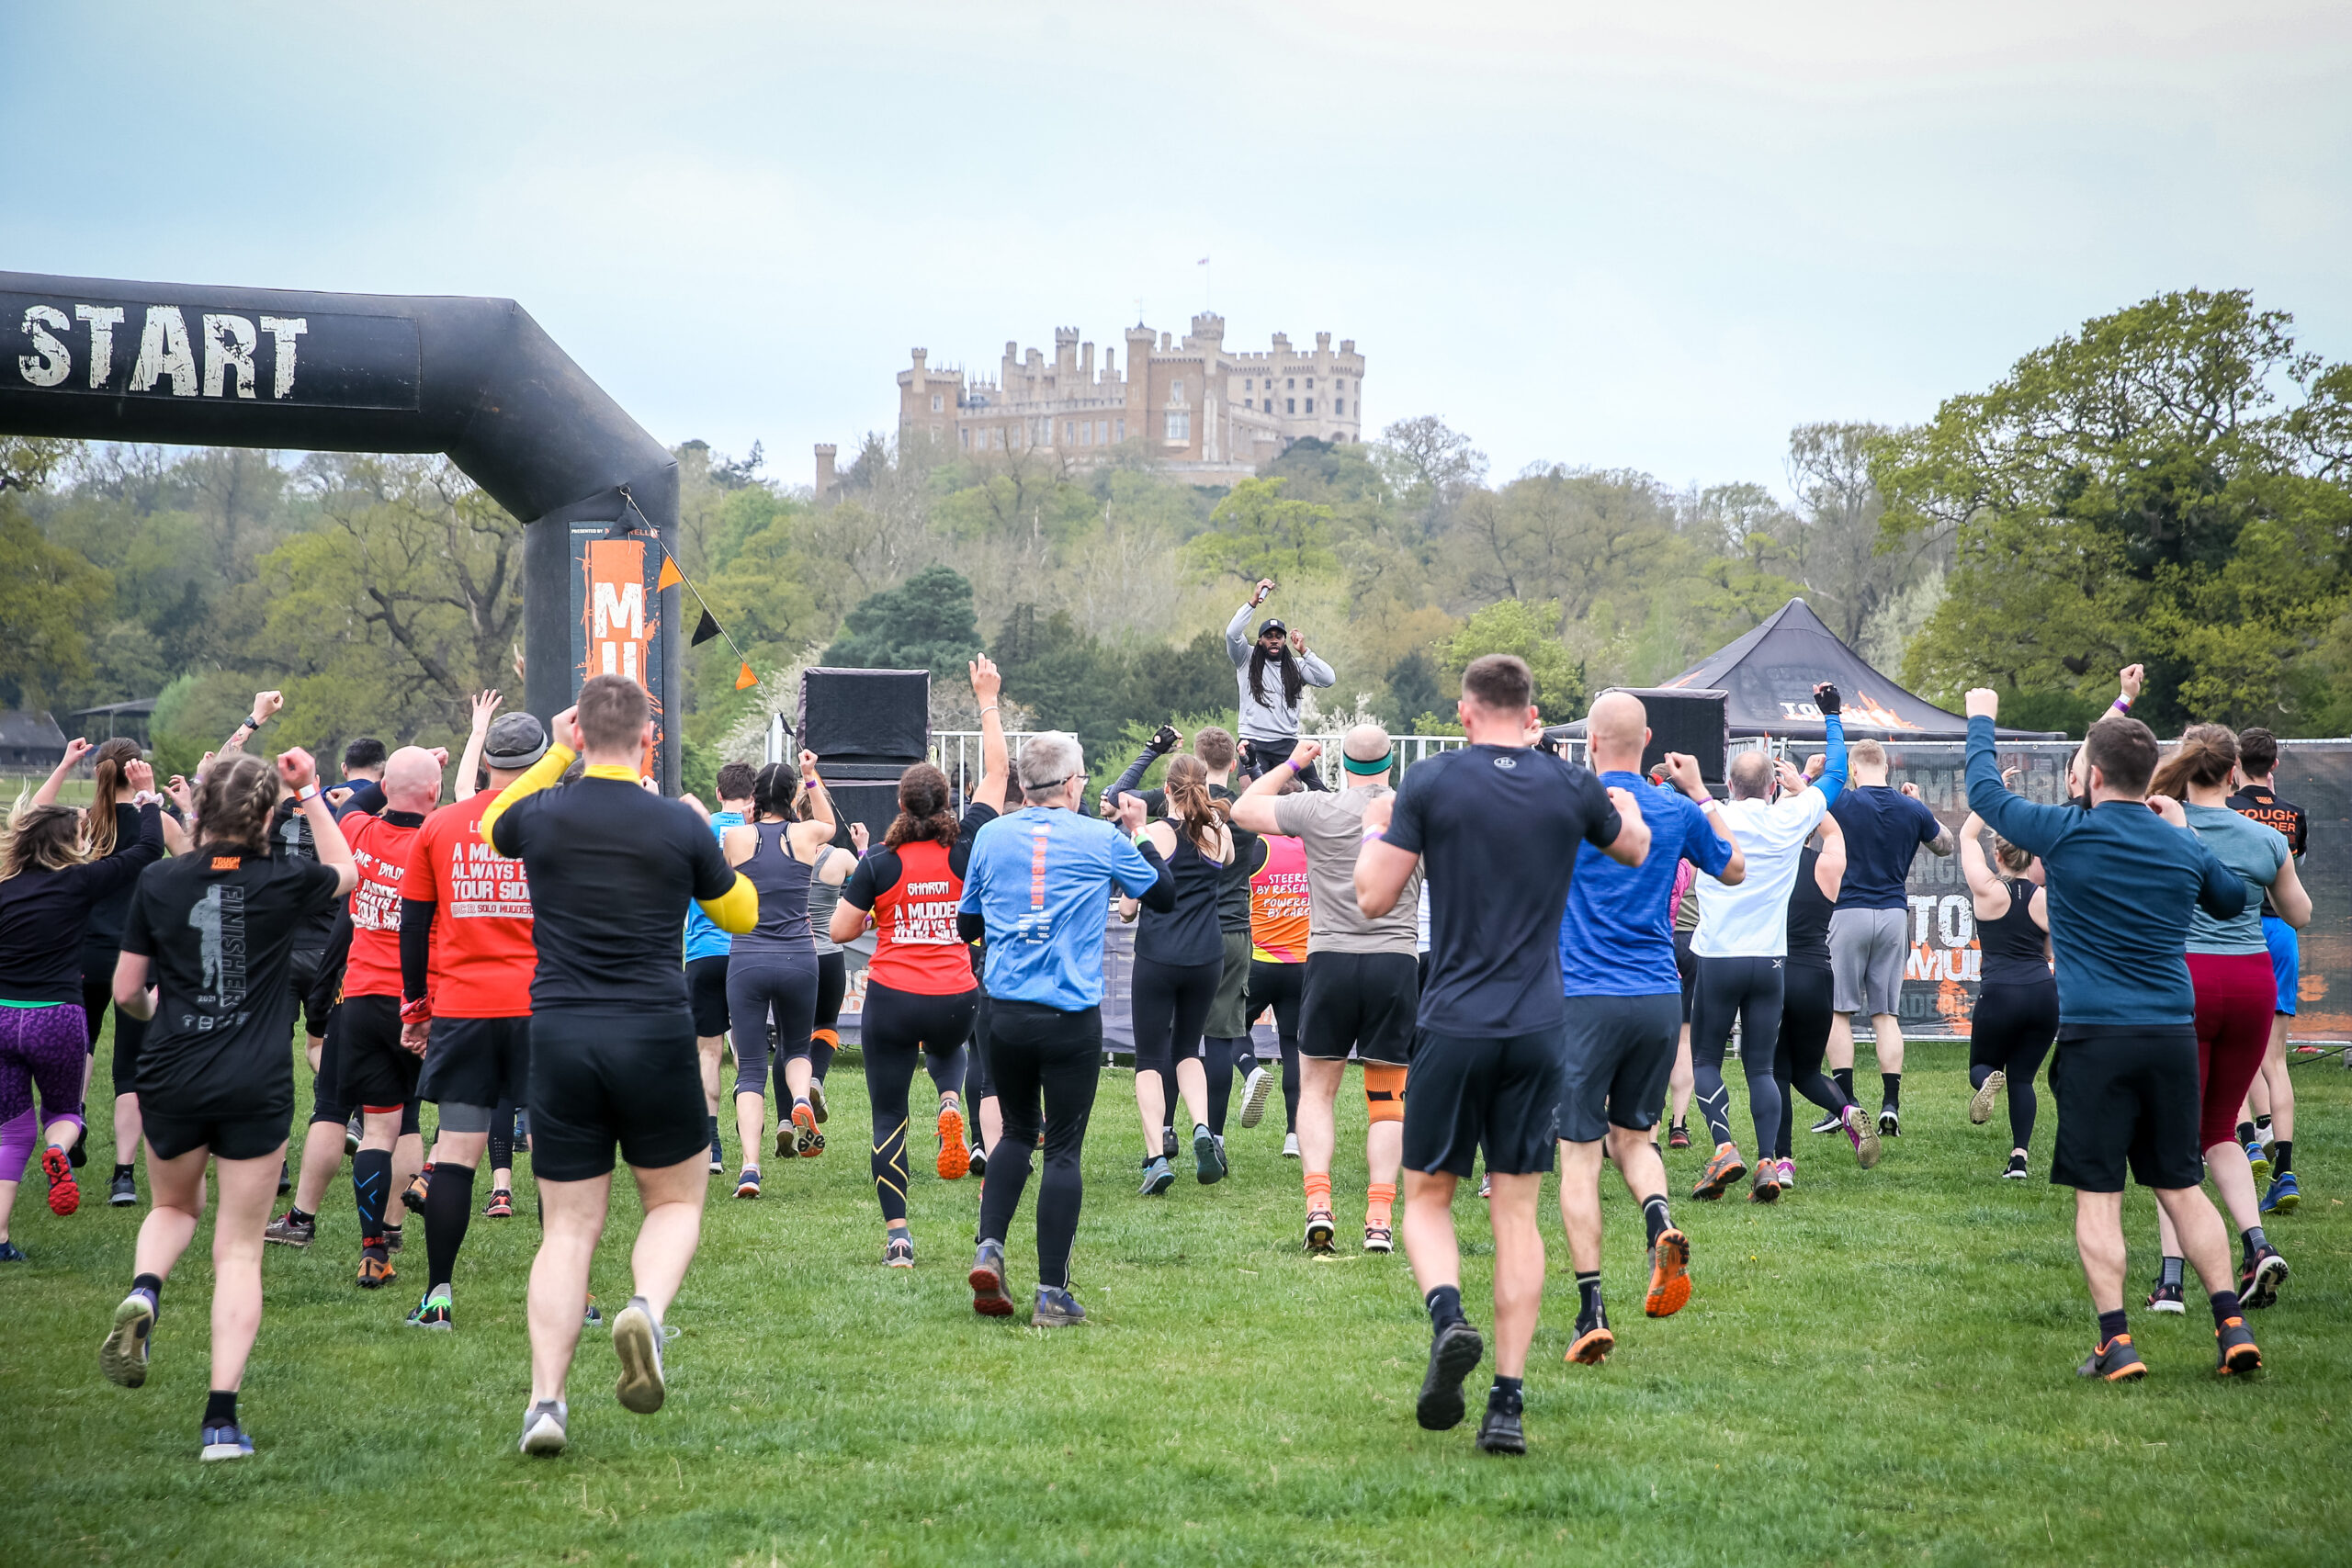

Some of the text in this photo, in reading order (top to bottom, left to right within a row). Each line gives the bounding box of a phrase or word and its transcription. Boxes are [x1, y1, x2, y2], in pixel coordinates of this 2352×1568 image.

[18, 304, 308, 399] START
[452, 842, 463, 862] A
[451, 863, 514, 880] ALWAYS
[451, 880, 494, 900] YOUR
[907, 881, 950, 897] SHARON
[1257, 885, 1270, 895] BY
[477, 904, 497, 913] SOLO
[894, 904, 903, 919] A
[1268, 908, 1282, 918] BY
[220, 885, 246, 1008] FINISHER
